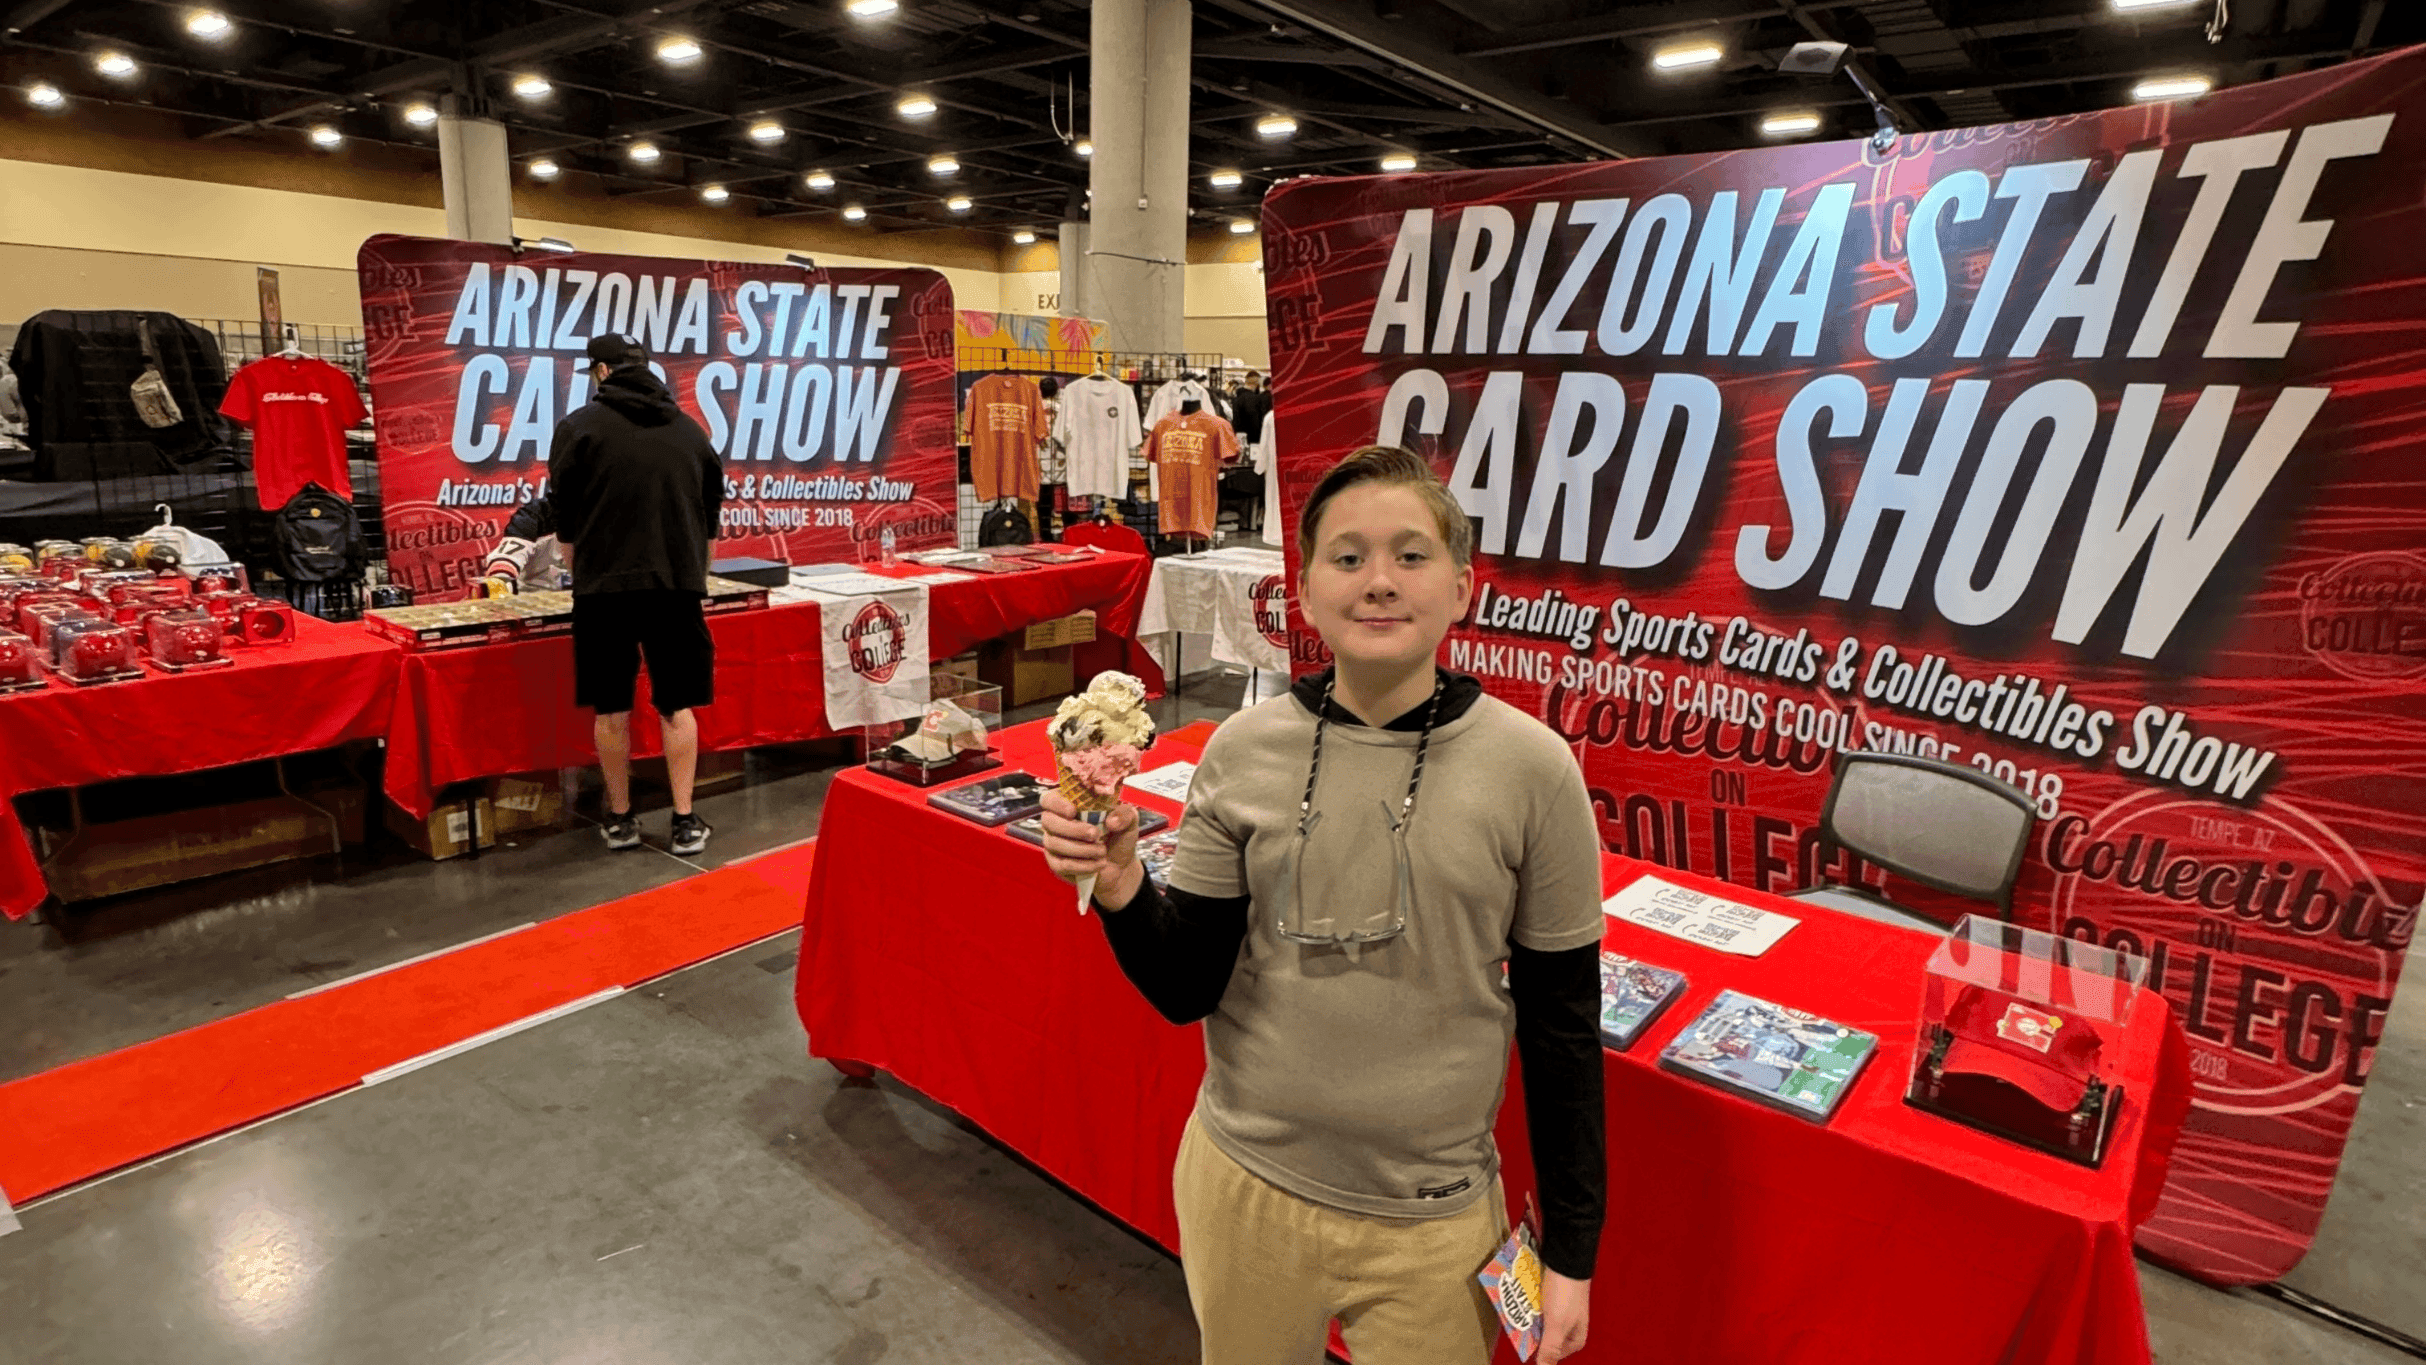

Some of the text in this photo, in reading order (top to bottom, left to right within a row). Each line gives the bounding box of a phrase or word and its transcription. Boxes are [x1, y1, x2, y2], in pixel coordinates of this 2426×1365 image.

[1362, 113, 2396, 359] ARIZONA STATE
[445, 262, 708, 354] ARIZONA
[727, 280, 900, 359] STATE
[1038, 294, 1060, 310] EX
[695, 361, 901, 462] SHOW
[436, 478, 533, 507] Arizona's
[741, 474, 757, 499] &
[760, 475, 864, 501] Collectibles
[867, 477, 915, 501] Show
[719, 508, 854, 527] COOL SINCE 2018
[1735, 374, 2333, 660] SHOW
[1449, 638, 1553, 684] MAKING
[1560, 655, 1666, 706] SPORTS
[1673, 675, 1769, 730] CARDS
[1776, 698, 1852, 754] COOL
[1475, 582, 1600, 650] Leading
[1604, 597, 1713, 659] Sports
[1720, 615, 1823, 683] Cards
[1826, 636, 1861, 692] &
[1862, 644, 2115, 758] Collectibles
[2116, 704, 2279, 800] Show
[1711, 768, 1746, 807] ON
[2252, 829, 2276, 852] AZ
[2201, 917, 2235, 951] ON
[2191, 1049, 2229, 1081] 2018
